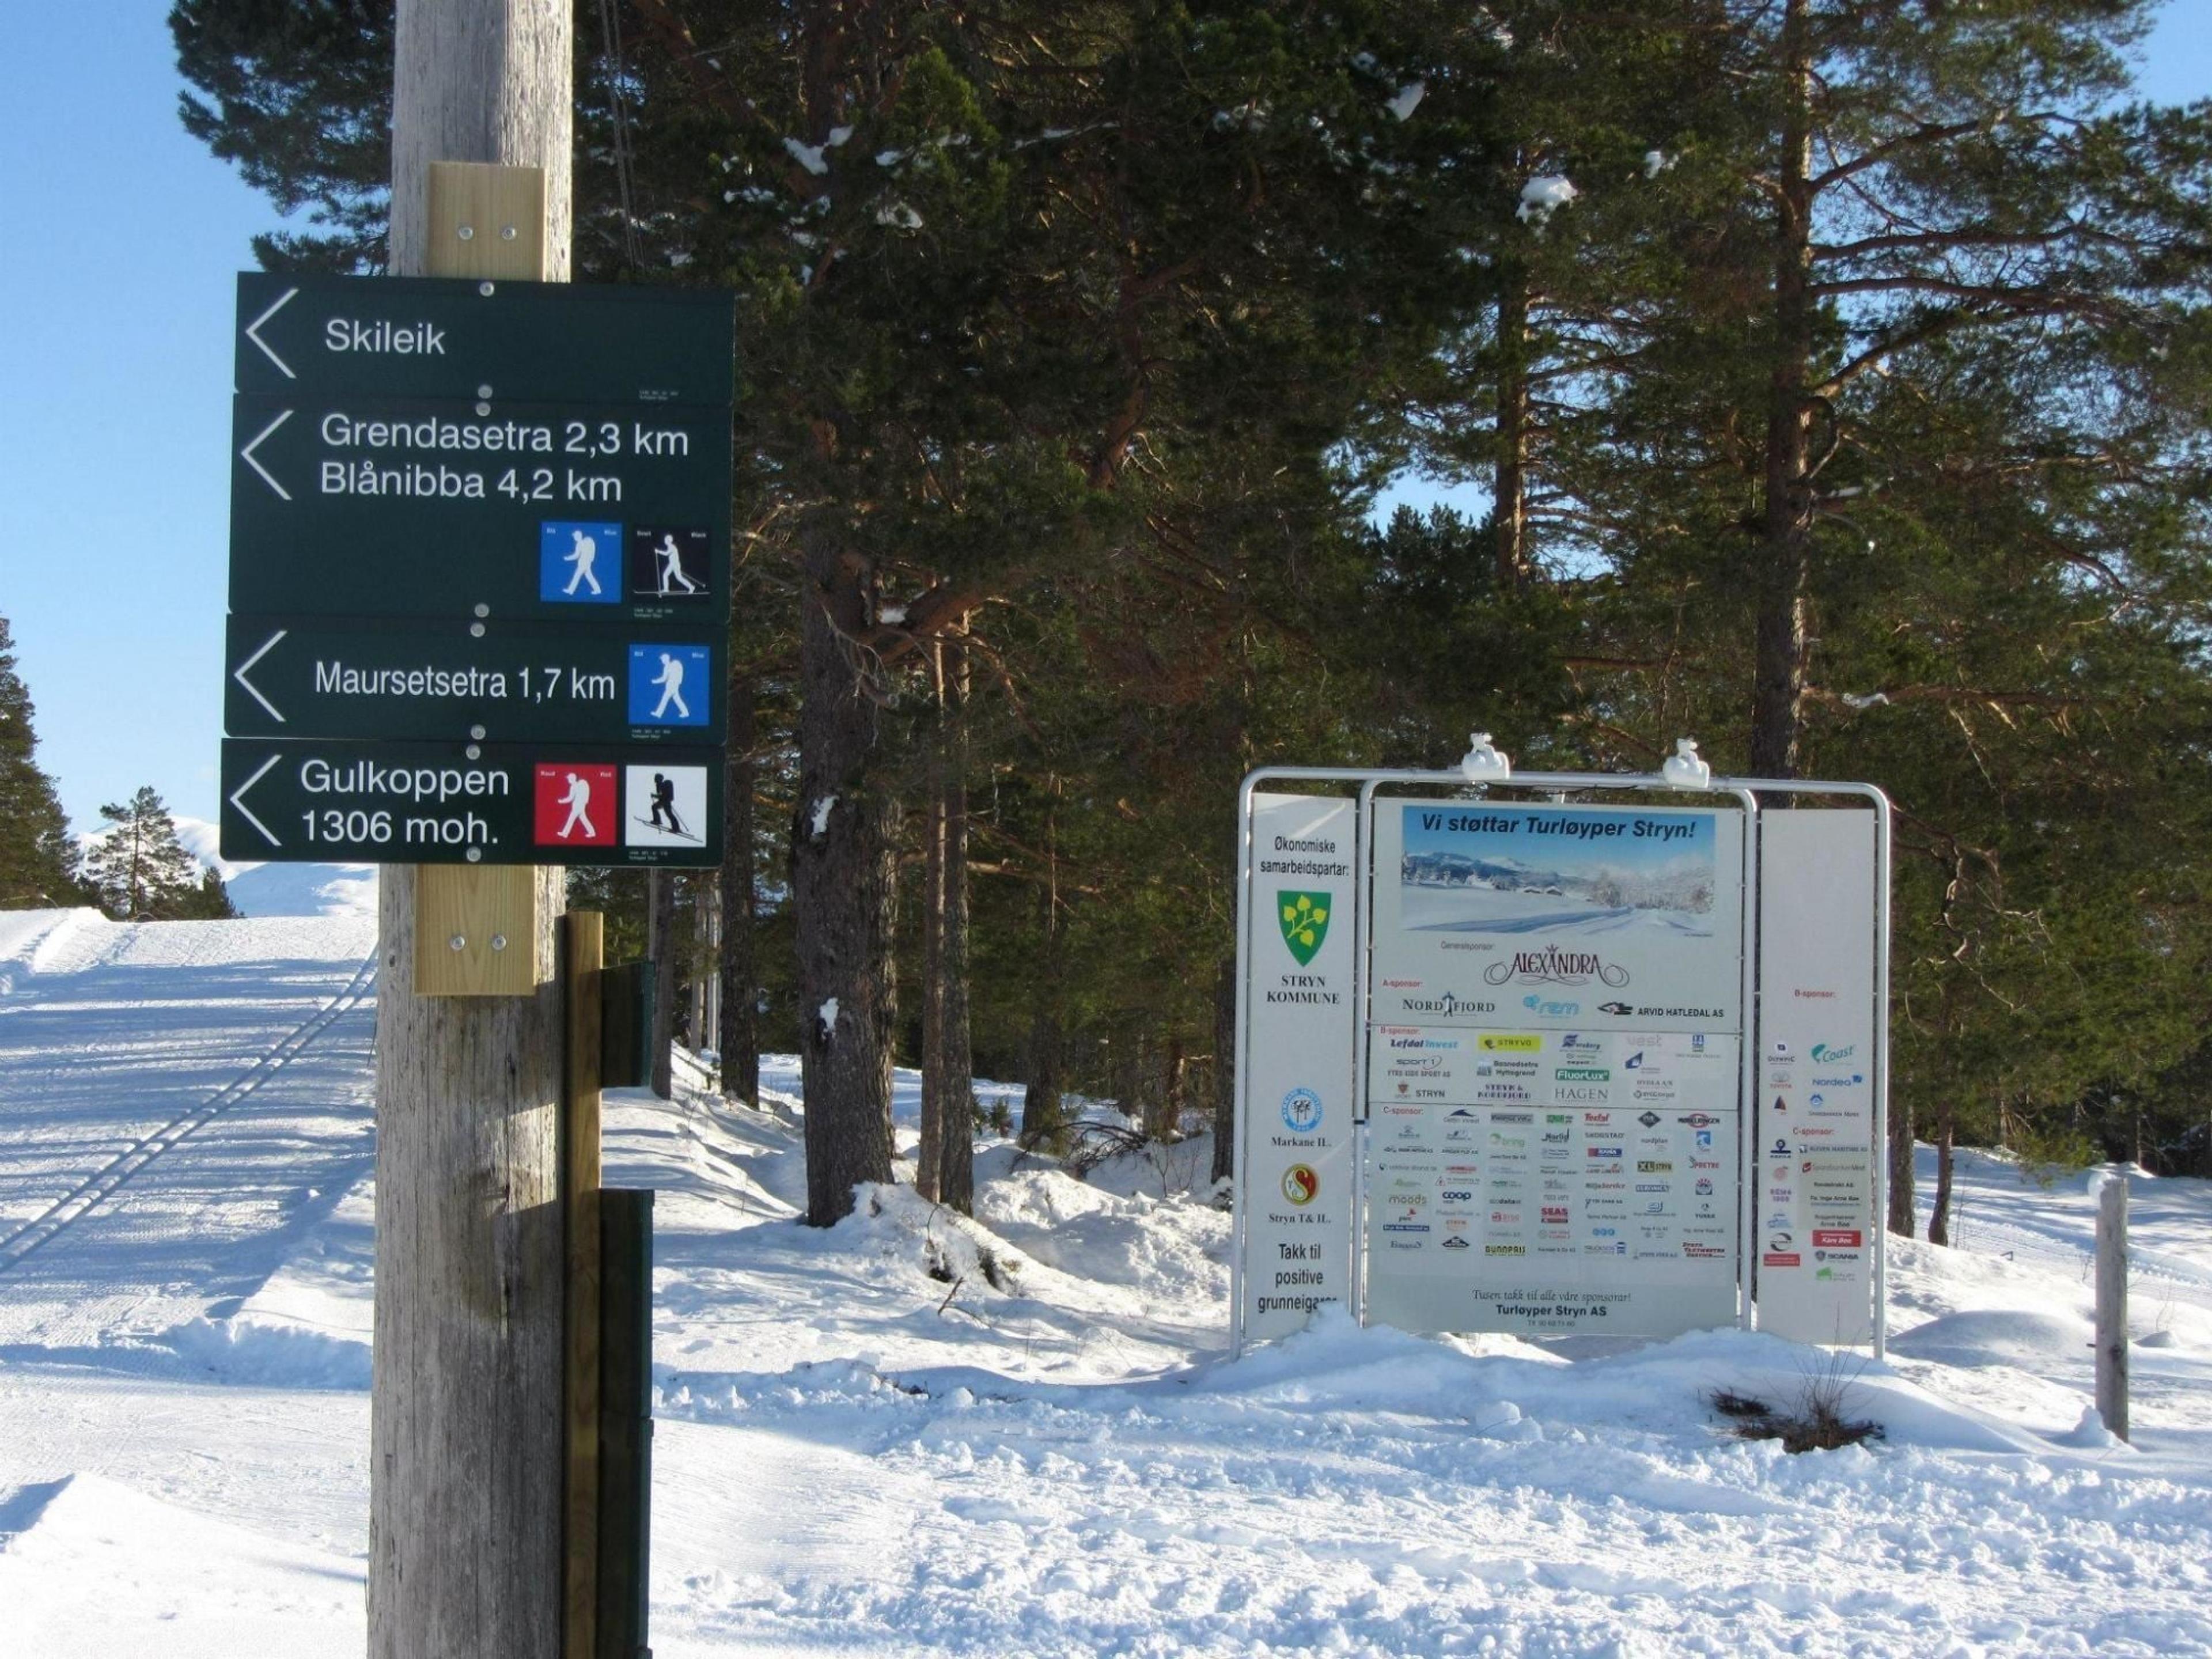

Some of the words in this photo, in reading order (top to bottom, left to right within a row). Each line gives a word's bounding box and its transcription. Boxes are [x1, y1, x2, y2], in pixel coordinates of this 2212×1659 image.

[325, 319, 446, 355] Skileik
[321, 413, 552, 453] Grendasetra
[565, 423, 621, 459] 2,3
[634, 423, 689, 456] km
[320, 461, 486, 499] Blånibba
[498, 469, 555, 505] 4,2
[567, 469, 622, 502] km
[316, 661, 507, 698] Maursetsetra
[519, 668, 561, 703] 1,7
[572, 668, 615, 700] km
[301, 759, 509, 802] Gulkoppen
[302, 810, 392, 843] 1306
[406, 812, 499, 844] moh.
[1422, 813, 1443, 831] Vi
[1448, 816, 1520, 834] støttar
[1527, 817, 1627, 840] Turløyper
[1633, 820, 1697, 842] Stryn!
[1274, 836, 1336, 854] Økonomiske
[1260, 859, 1349, 878] samarbeidspartar:
[1281, 975, 1326, 987] STRYN
[1382, 979, 1423, 990] A-sponsor:
[1267, 991, 1340, 1005] KOMMUNE
[1794, 990, 1836, 998] B-sponsor:
[1638, 1007, 1664, 1016] ARVID
[1665, 1007, 1711, 1017] HATLEDAL
[1713, 1009, 1724, 1017] AS
[1823, 1045, 1854, 1063] Coast
[1812, 1078, 1852, 1086] Nordea
[1415, 1089, 1445, 1097] STRYN
[1555, 1088, 1608, 1099] HAGEN
[1383, 1107, 1424, 1115] C-sponsor:
[1793, 1127, 1834, 1135] C-sponsor:
[1271, 1137, 1315, 1147] Markane
[1388, 1194, 1427, 1205] moods
[1442, 1191, 1471, 1202] coop
[1268, 1213, 1296, 1226] Stryn
[1278, 1243, 1306, 1260] Takk
[1309, 1244, 1321, 1260] til
[1275, 1269, 1324, 1289] positive
[1473, 1289, 1501, 1300] Tusen
[1503, 1289, 1524, 1300] takk
[1527, 1290, 1537, 1300] til
[1539, 1290, 1556, 1301] alle
[1496, 1304, 1552, 1317] Turløyper
[1555, 1305, 1587, 1318] Stryn
[1590, 1306, 1607, 1316] AS
